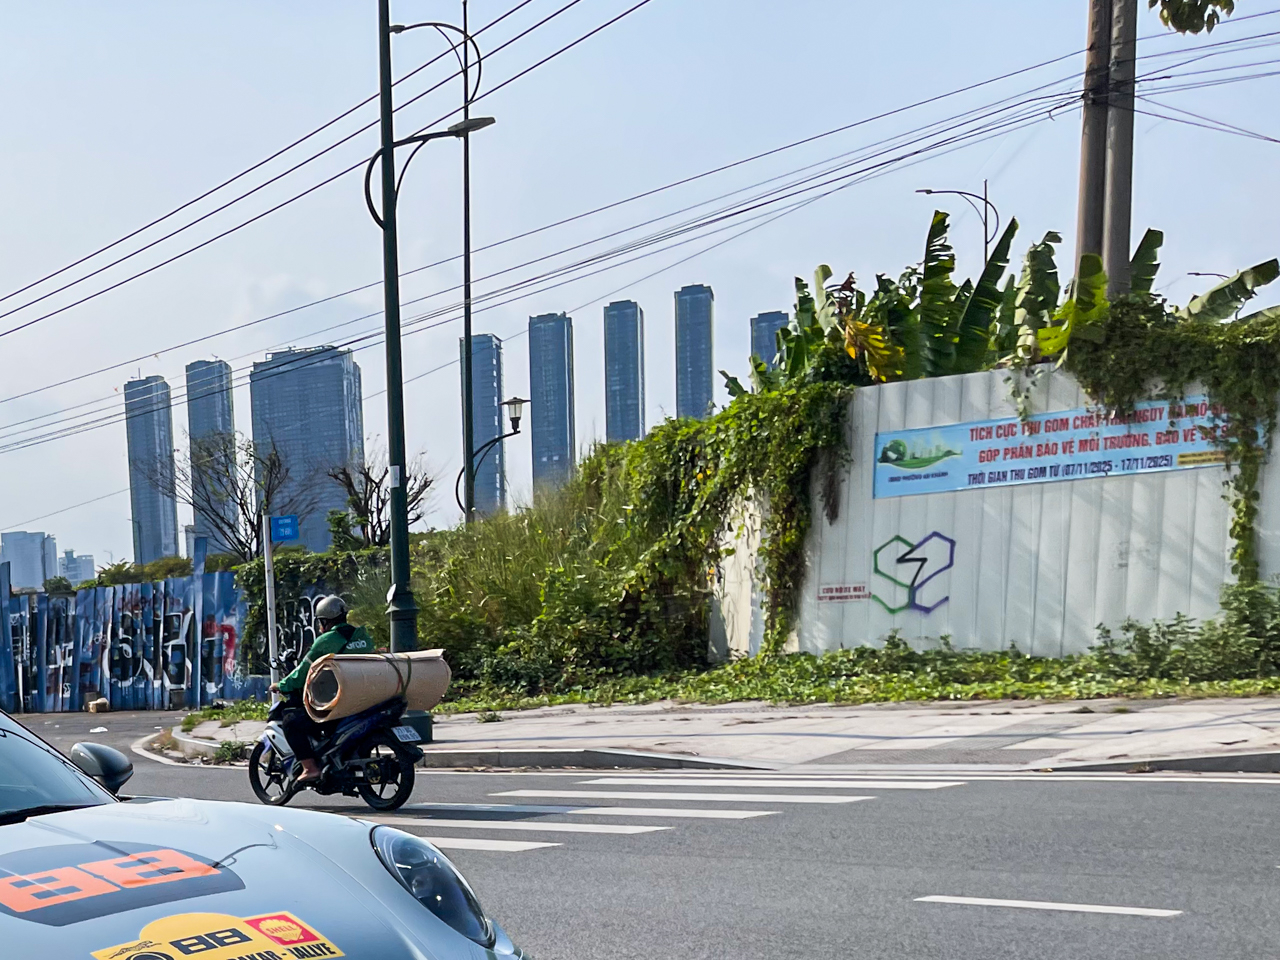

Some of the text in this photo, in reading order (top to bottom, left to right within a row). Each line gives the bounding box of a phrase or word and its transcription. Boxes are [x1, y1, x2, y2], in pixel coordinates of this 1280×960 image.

[1045, 418, 1069, 432] GOM
[988, 471, 1007, 483] GIAN
[1010, 469, 1025, 481] THU
[1028, 466, 1046, 479] GOM
[169, 927, 253, 955] 88
